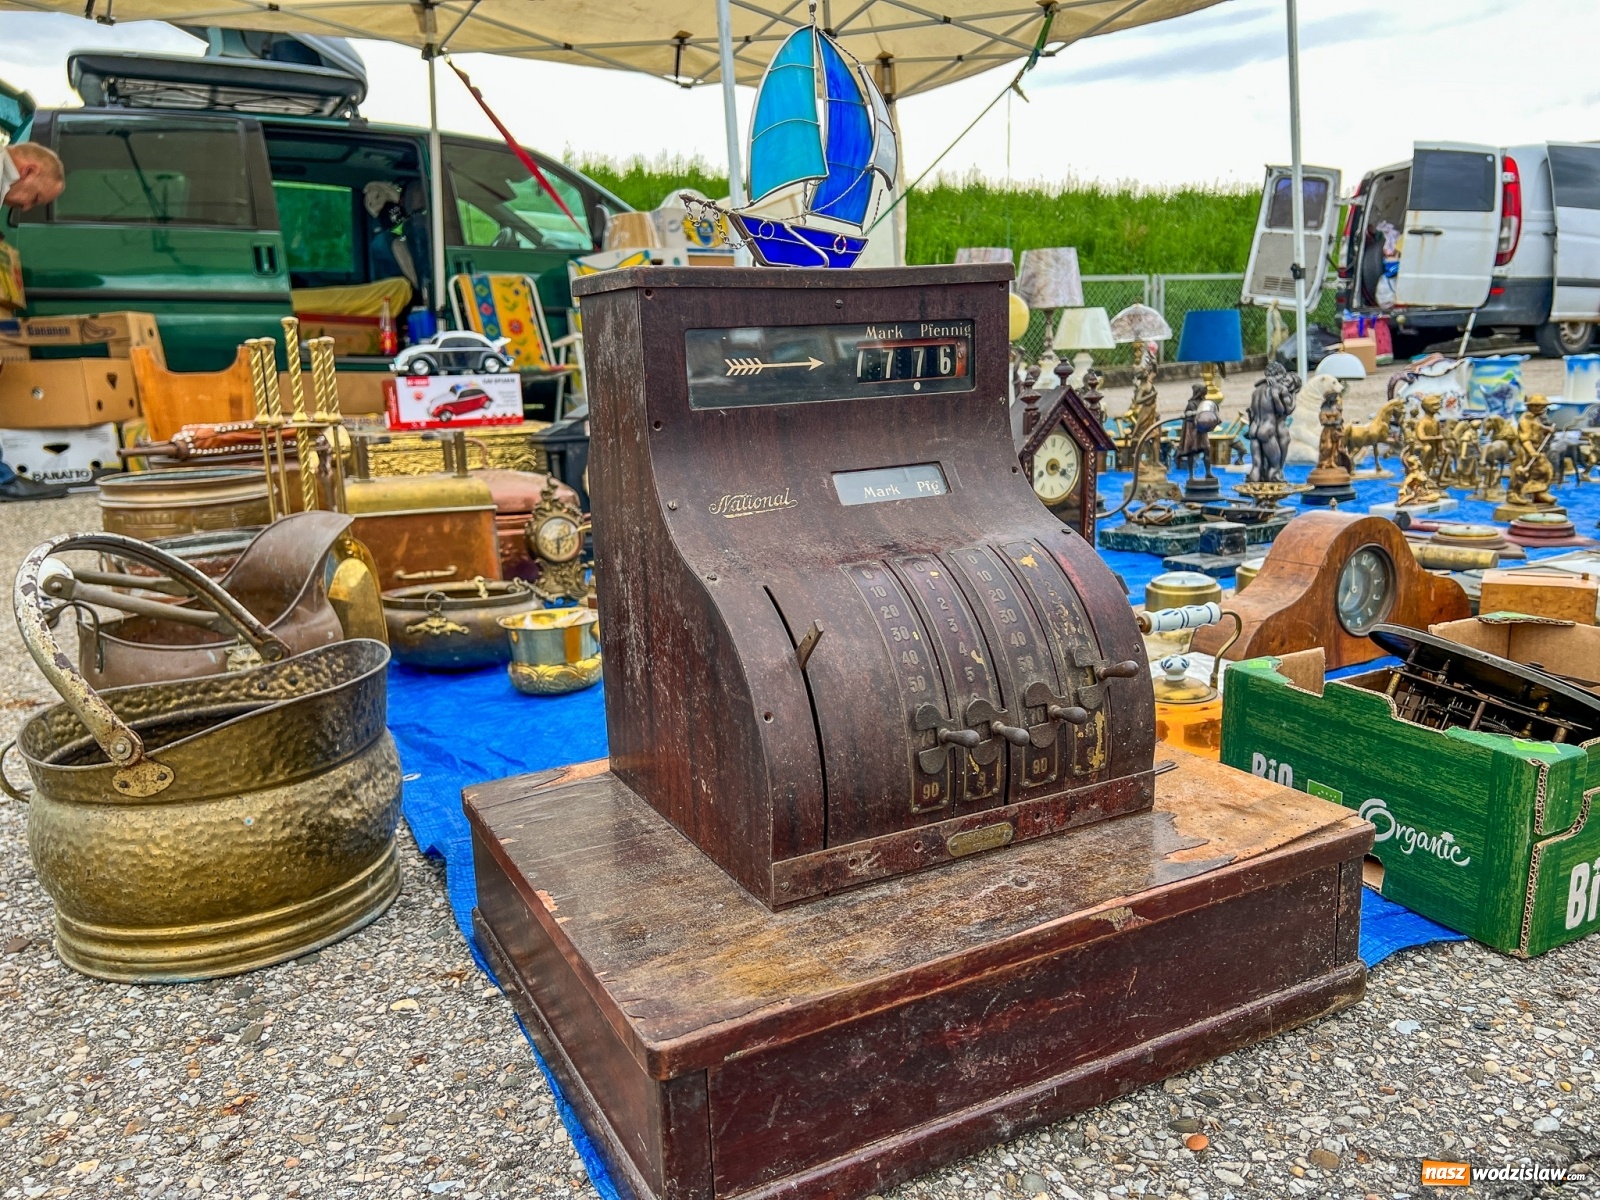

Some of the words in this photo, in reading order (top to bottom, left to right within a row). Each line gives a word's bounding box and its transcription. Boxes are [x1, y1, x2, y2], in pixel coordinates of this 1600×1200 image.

[865, 325, 903, 340] Mark
[920, 323, 971, 339] Pfennig
[863, 484, 901, 499] Mark
[916, 480, 940, 495] Pfg
[708, 487, 798, 517] National
[976, 570, 993, 583] 10
[870, 585, 888, 598] 10
[988, 588, 1007, 602] 20
[881, 604, 900, 619] 20
[890, 625, 910, 642] 30
[1010, 631, 1027, 648] 40
[902, 649, 920, 666] 40
[907, 674, 927, 693] 50
[1032, 757, 1048, 775] 90
[923, 781, 940, 800] 90
[1358, 797, 1471, 868] Organic
